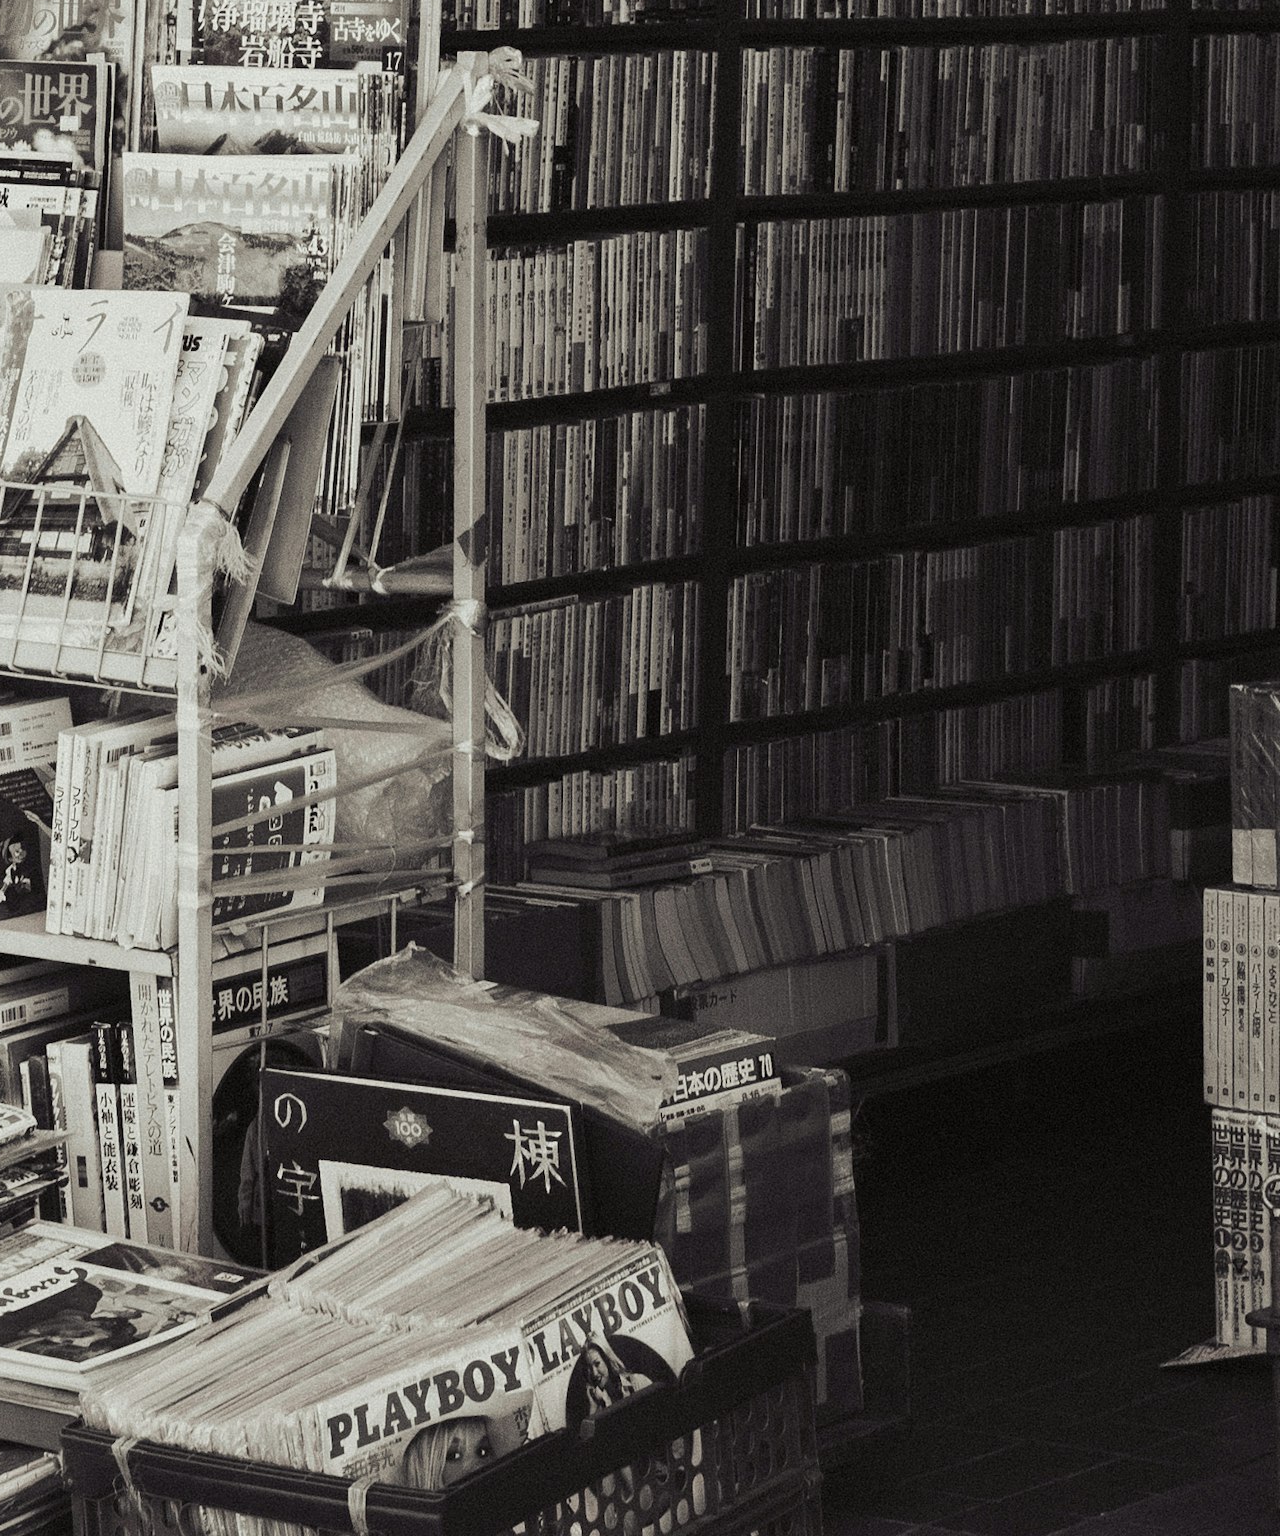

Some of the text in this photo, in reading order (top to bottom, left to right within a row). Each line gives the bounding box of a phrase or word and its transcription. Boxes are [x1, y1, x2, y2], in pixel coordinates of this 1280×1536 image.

[211, 1, 324, 34] 浄瑠璃寺
[239, 36, 323, 69] 岩船寺
[333, 17, 402, 43] 古寺をゆく
[386, 51, 402, 70] 17
[213, 975, 289, 1024] 界の民族
[1221, 957, 1231, 1022] テーブルマナー
[137, 984, 164, 1156] 開かれたテレトピアへの道
[157, 989, 178, 1080] 世界の民族
[673, 1053, 773, 1103] 日本の歴史 70
[99, 1092, 120, 1192] 小袖と能衣装
[122, 1091, 144, 1211] 運慶と鎌倉彫刻
[394, 1121, 421, 1137] 100
[504, 1119, 566, 1193] 棟
[1214, 1124, 1231, 1228] 世界の歴史
[1230, 1127, 1247, 1231] 世界の歴史
[1248, 1127, 1263, 1232] 世界の歴史
[327, 1345, 522, 1460] PLAYBOY
